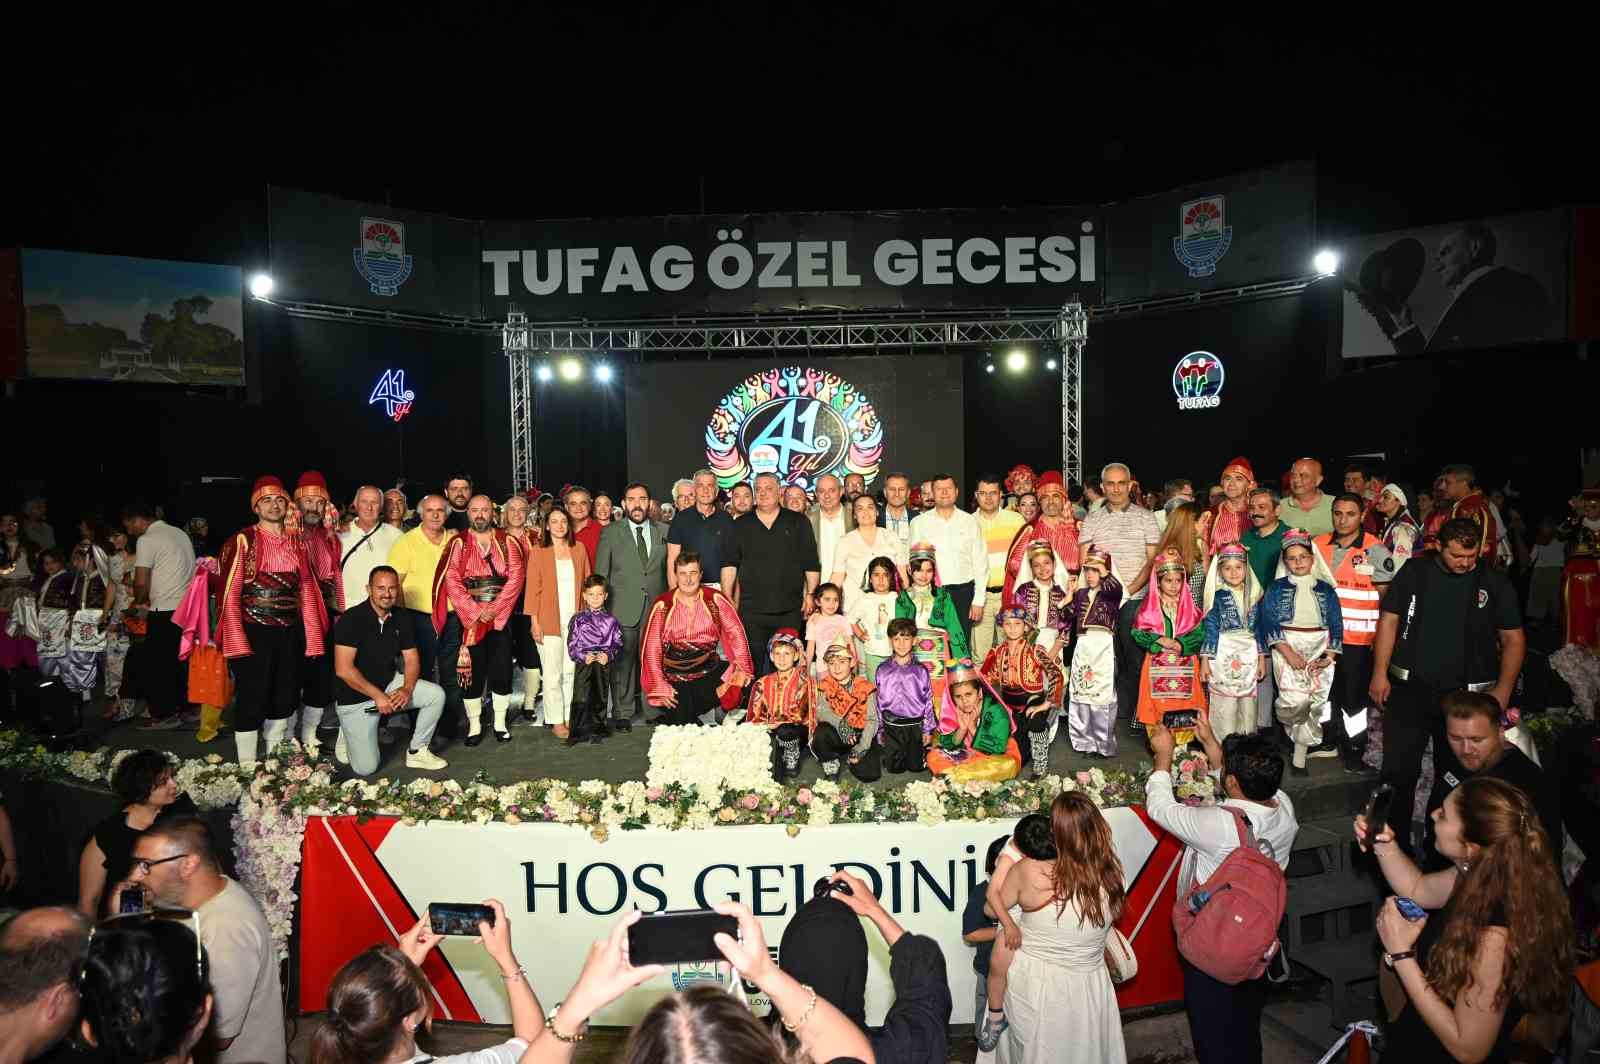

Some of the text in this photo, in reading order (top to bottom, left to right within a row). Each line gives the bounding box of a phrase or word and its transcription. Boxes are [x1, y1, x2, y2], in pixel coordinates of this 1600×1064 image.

[482, 244, 695, 296] TUFAG
[707, 228, 862, 290] ÖZEL
[873, 220, 1096, 287] GECESİ
[1177, 395, 1221, 410] TUFAG
